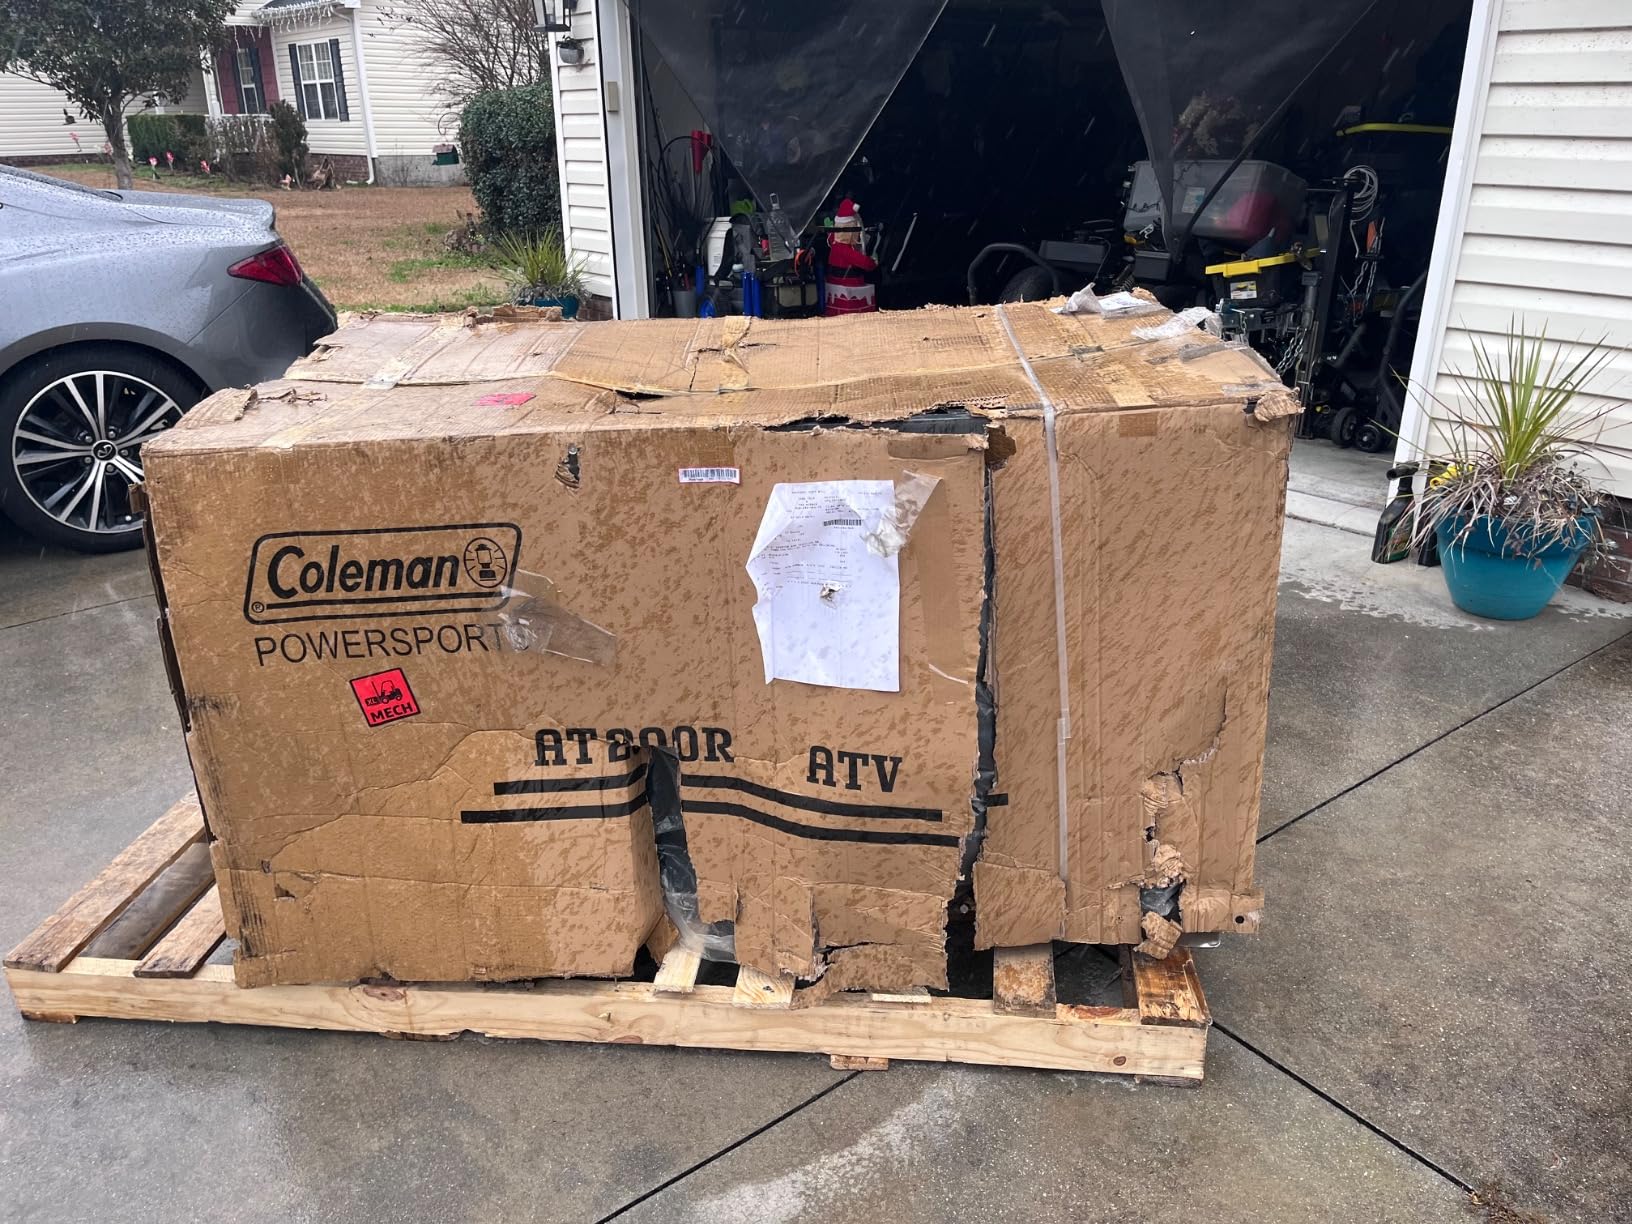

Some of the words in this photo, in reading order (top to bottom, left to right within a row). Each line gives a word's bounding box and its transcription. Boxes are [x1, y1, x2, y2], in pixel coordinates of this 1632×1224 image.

[267, 544, 460, 600] Coleman
[254, 622, 529, 667] POWERSPORT
[369, 701, 415, 723] MECH
[806, 745, 903, 793] ATV
